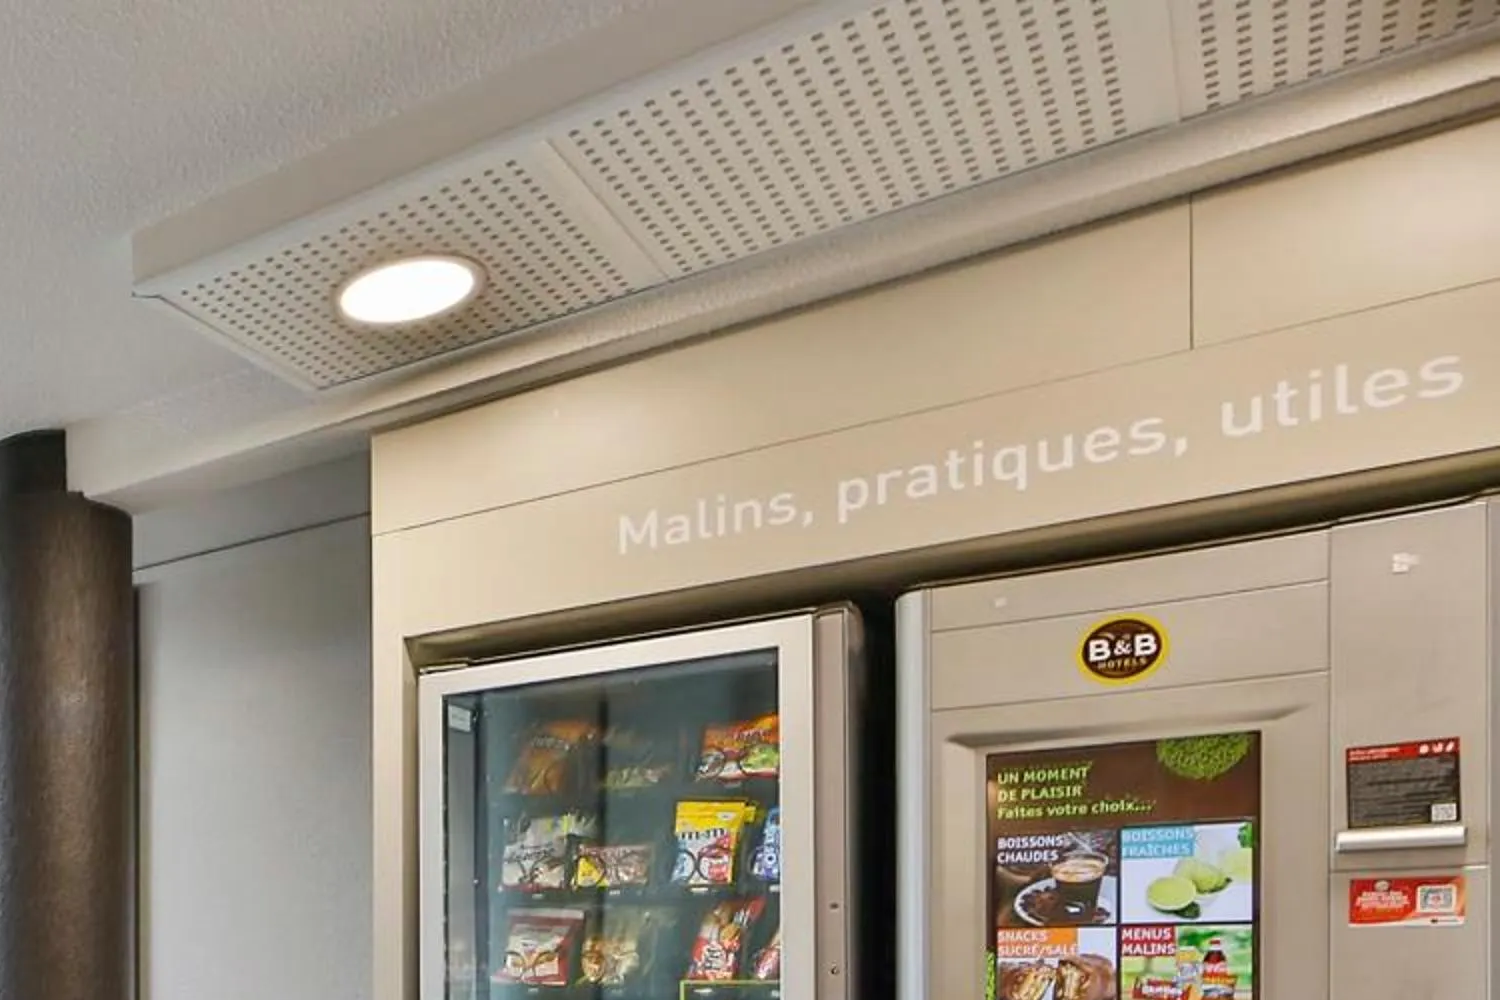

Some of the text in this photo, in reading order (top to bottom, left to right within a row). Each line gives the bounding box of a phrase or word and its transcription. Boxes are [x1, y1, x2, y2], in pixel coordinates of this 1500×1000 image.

[617, 352, 1464, 555] Malins, pratiques, utiles
[1087, 632, 1158, 663] B&B
[997, 766, 1087, 785] UN MOMENT
[997, 785, 1082, 802] DE PLAISIR
[997, 804, 1043, 820] Faites
[1046, 803, 1088, 817] votre
[997, 834, 1066, 850] BOISSONS
[1122, 827, 1194, 844] BOISSONS
[997, 849, 1059, 864] CHAUDES
[997, 929, 1048, 943] SNACKS
[1122, 927, 1172, 941] MENUS
[1122, 943, 1175, 955] MALINS
